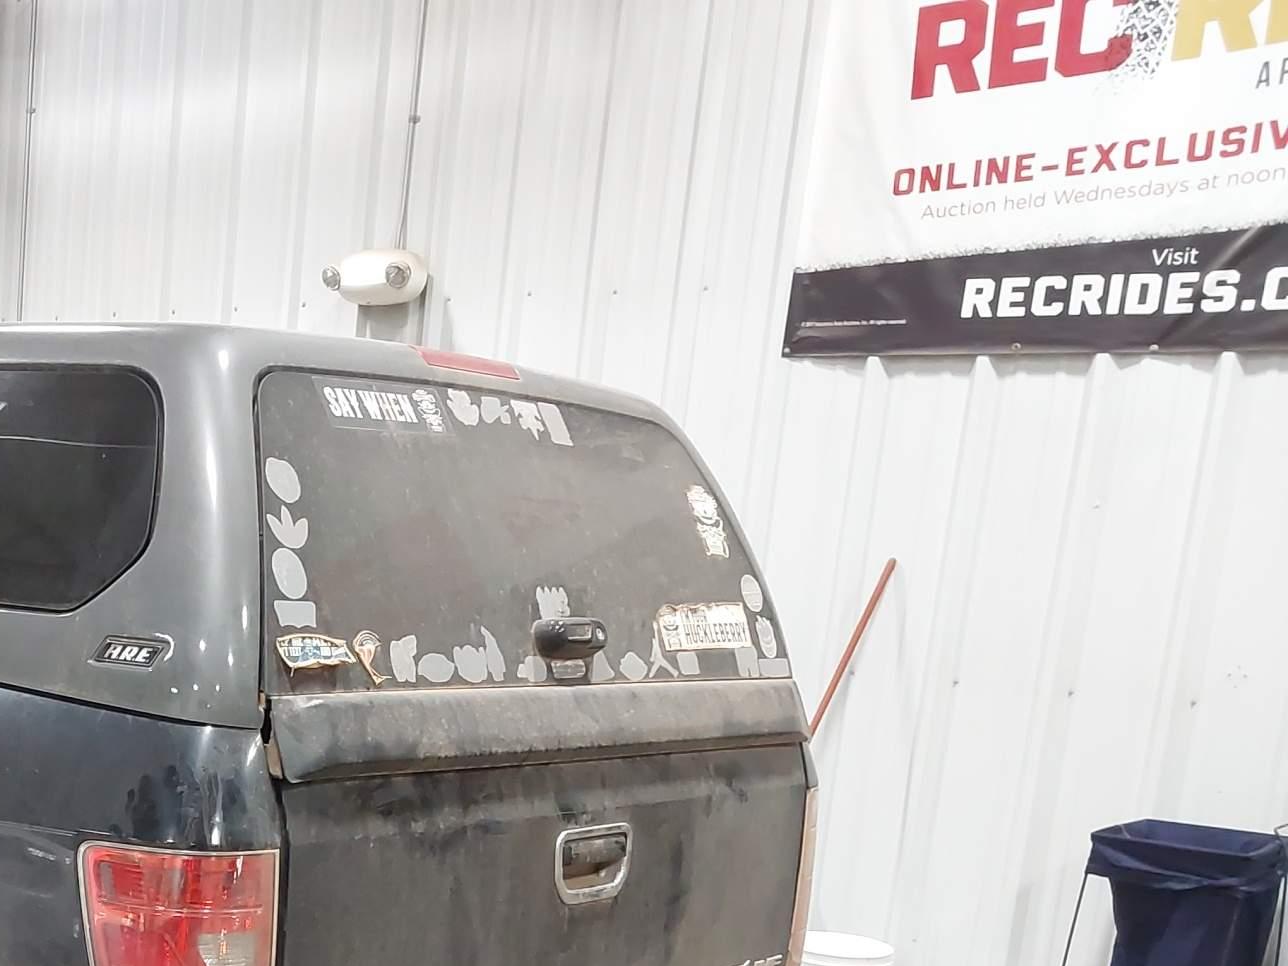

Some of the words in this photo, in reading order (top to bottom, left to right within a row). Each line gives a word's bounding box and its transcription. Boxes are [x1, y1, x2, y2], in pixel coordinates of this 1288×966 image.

[921, 200, 997, 220] Auction
[1003, 193, 1046, 212] held
[1053, 176, 1190, 206] Wednesdays
[1197, 175, 1219, 191] at
[1227, 167, 1287, 187] noon
[1152, 247, 1199, 266] Visit
[323, 386, 364, 419] SAY
[357, 389, 419, 423] WHEN
[683, 621, 749, 647] HUCKLEBERRY
